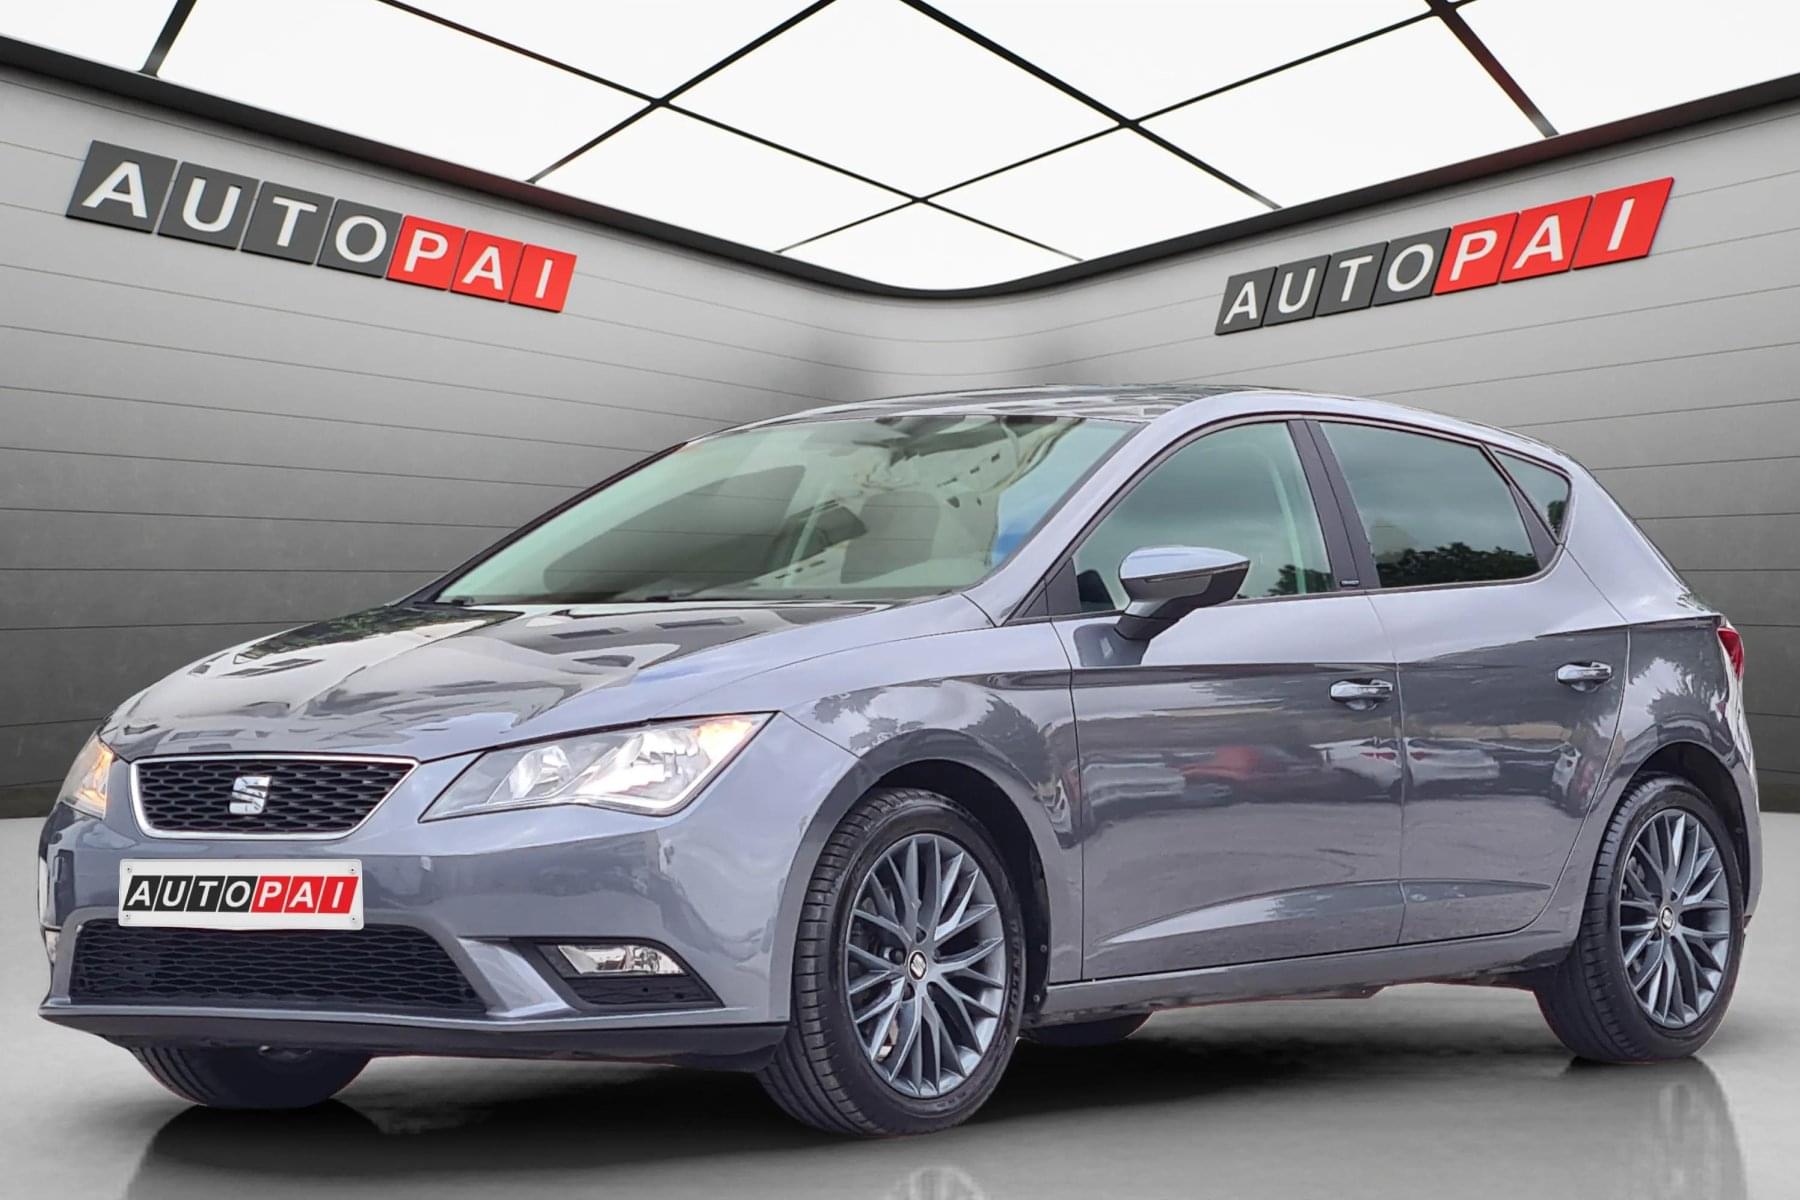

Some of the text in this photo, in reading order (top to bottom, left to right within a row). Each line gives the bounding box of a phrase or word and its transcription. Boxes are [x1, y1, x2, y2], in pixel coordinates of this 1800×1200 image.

[83, 161, 552, 299] AUTOPAI
[1223, 198, 1635, 324] AUTOPAI
[127, 880, 342, 909] AUTOPAI
